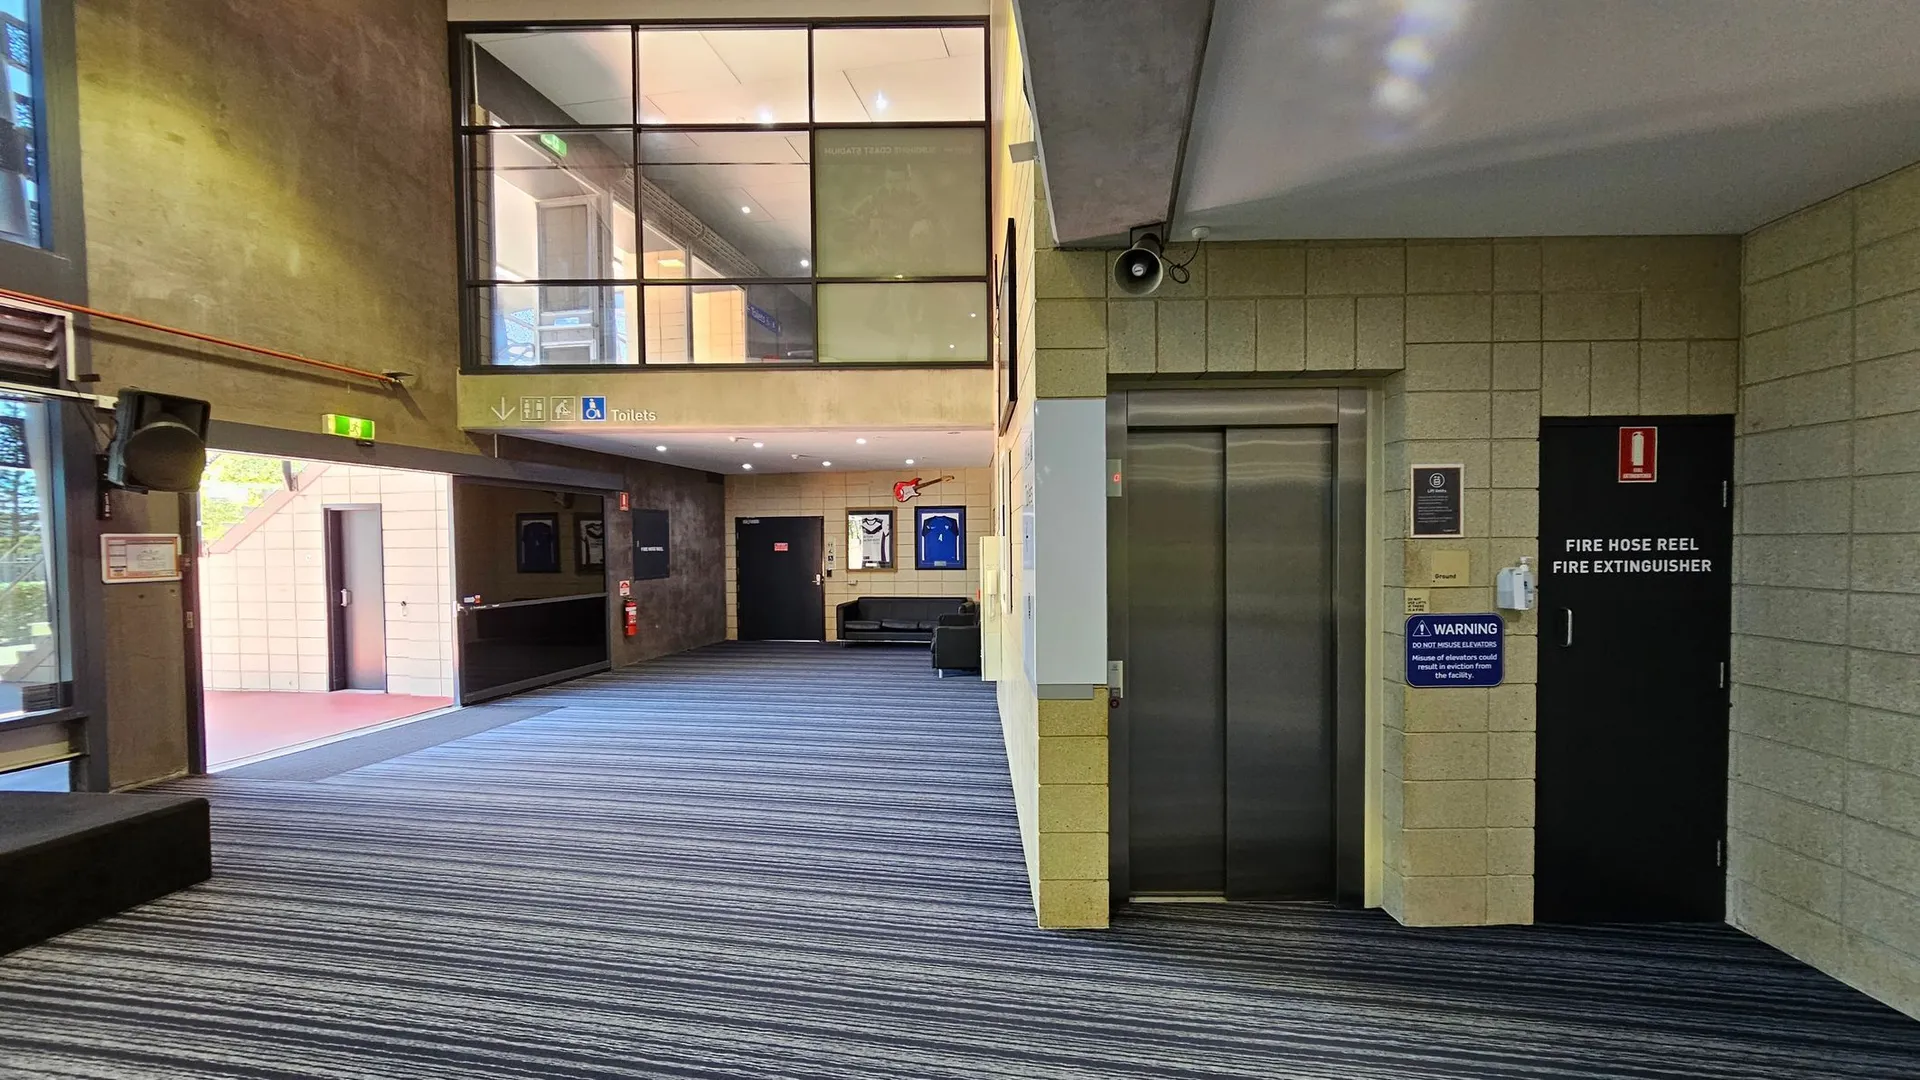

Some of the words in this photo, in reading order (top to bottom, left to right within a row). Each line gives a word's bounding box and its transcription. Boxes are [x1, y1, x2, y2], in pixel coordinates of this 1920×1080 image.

[611, 409, 657, 422] Toilets
[938, 533, 943, 542] 4
[1566, 539, 1603, 552] FIRE
[1608, 538, 1652, 551] HOSE
[1657, 538, 1700, 551] REEL
[1553, 560, 1589, 574] FIRE
[1593, 559, 1712, 573] EXTINGUISHER
[1433, 623, 1498, 635] WARNING
[1448, 671, 1475, 680] facility.
